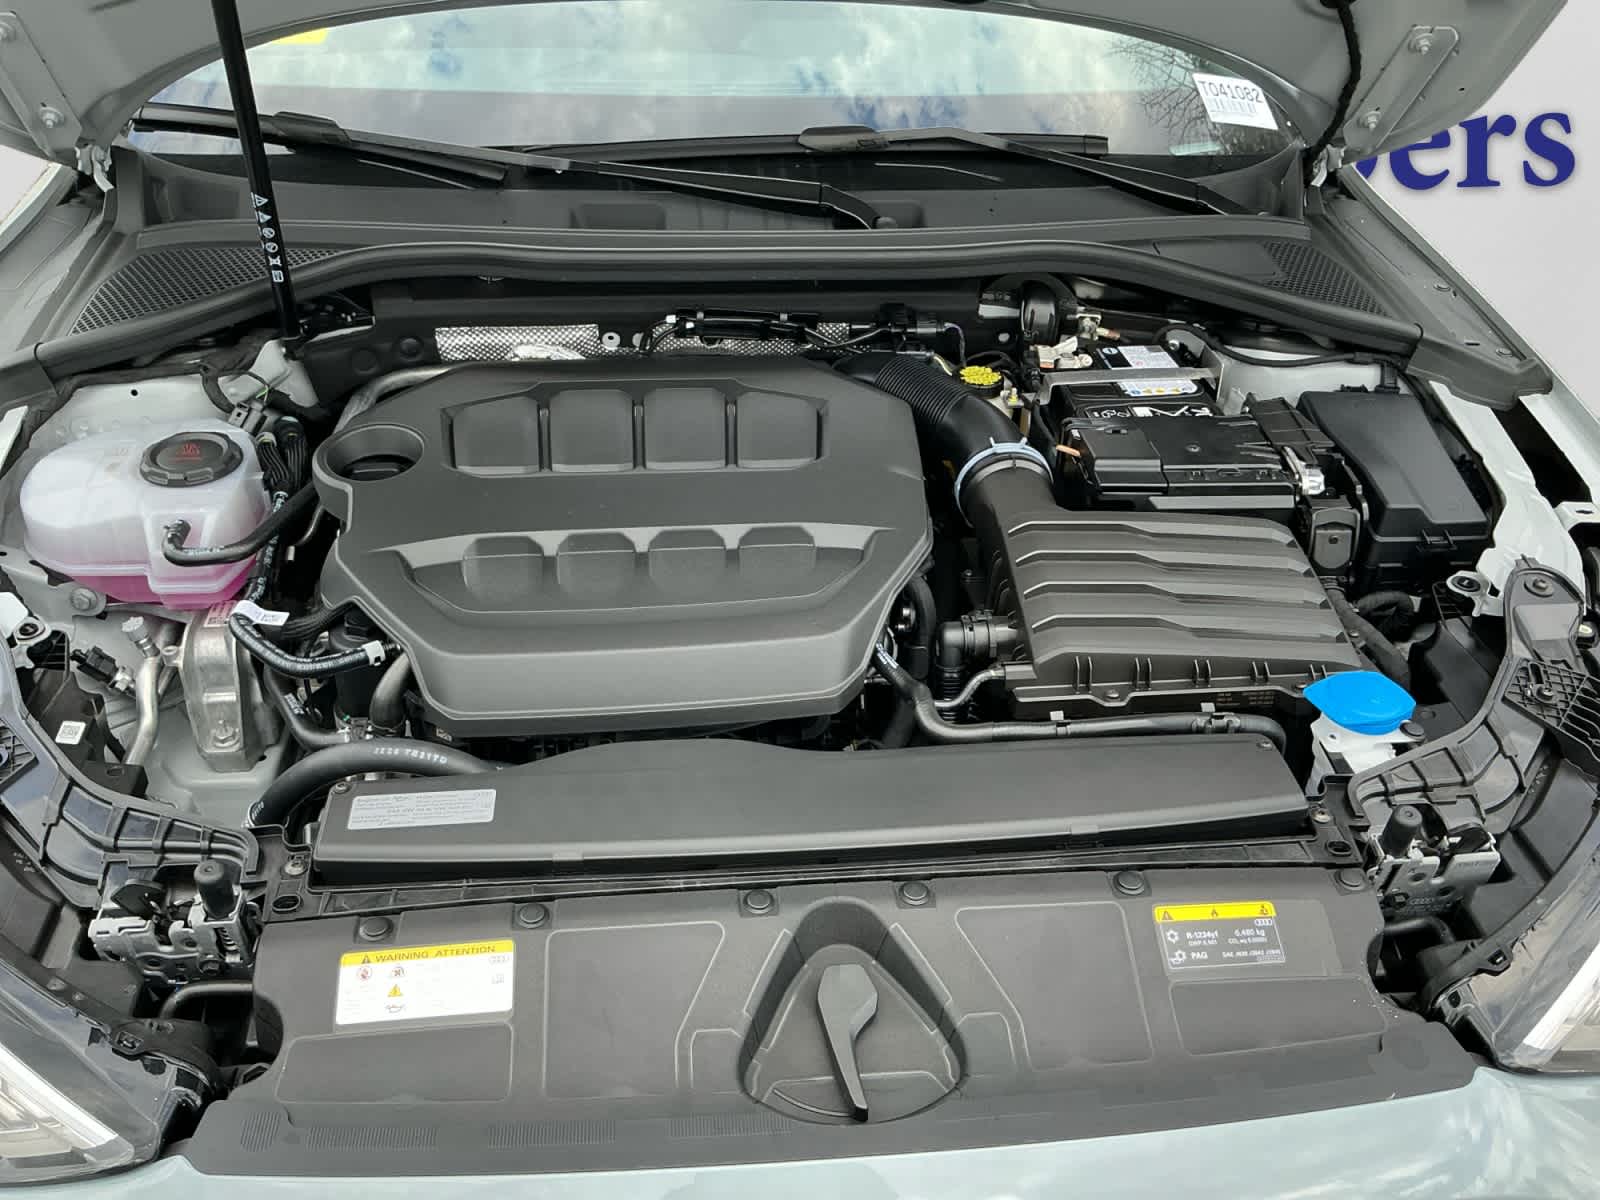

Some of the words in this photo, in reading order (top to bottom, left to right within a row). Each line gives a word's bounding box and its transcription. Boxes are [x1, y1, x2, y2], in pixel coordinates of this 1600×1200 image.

[1355, 113, 1575, 190] ers
[375, 952, 429, 963] WARNING
[434, 945, 497, 958] ATTENTION
